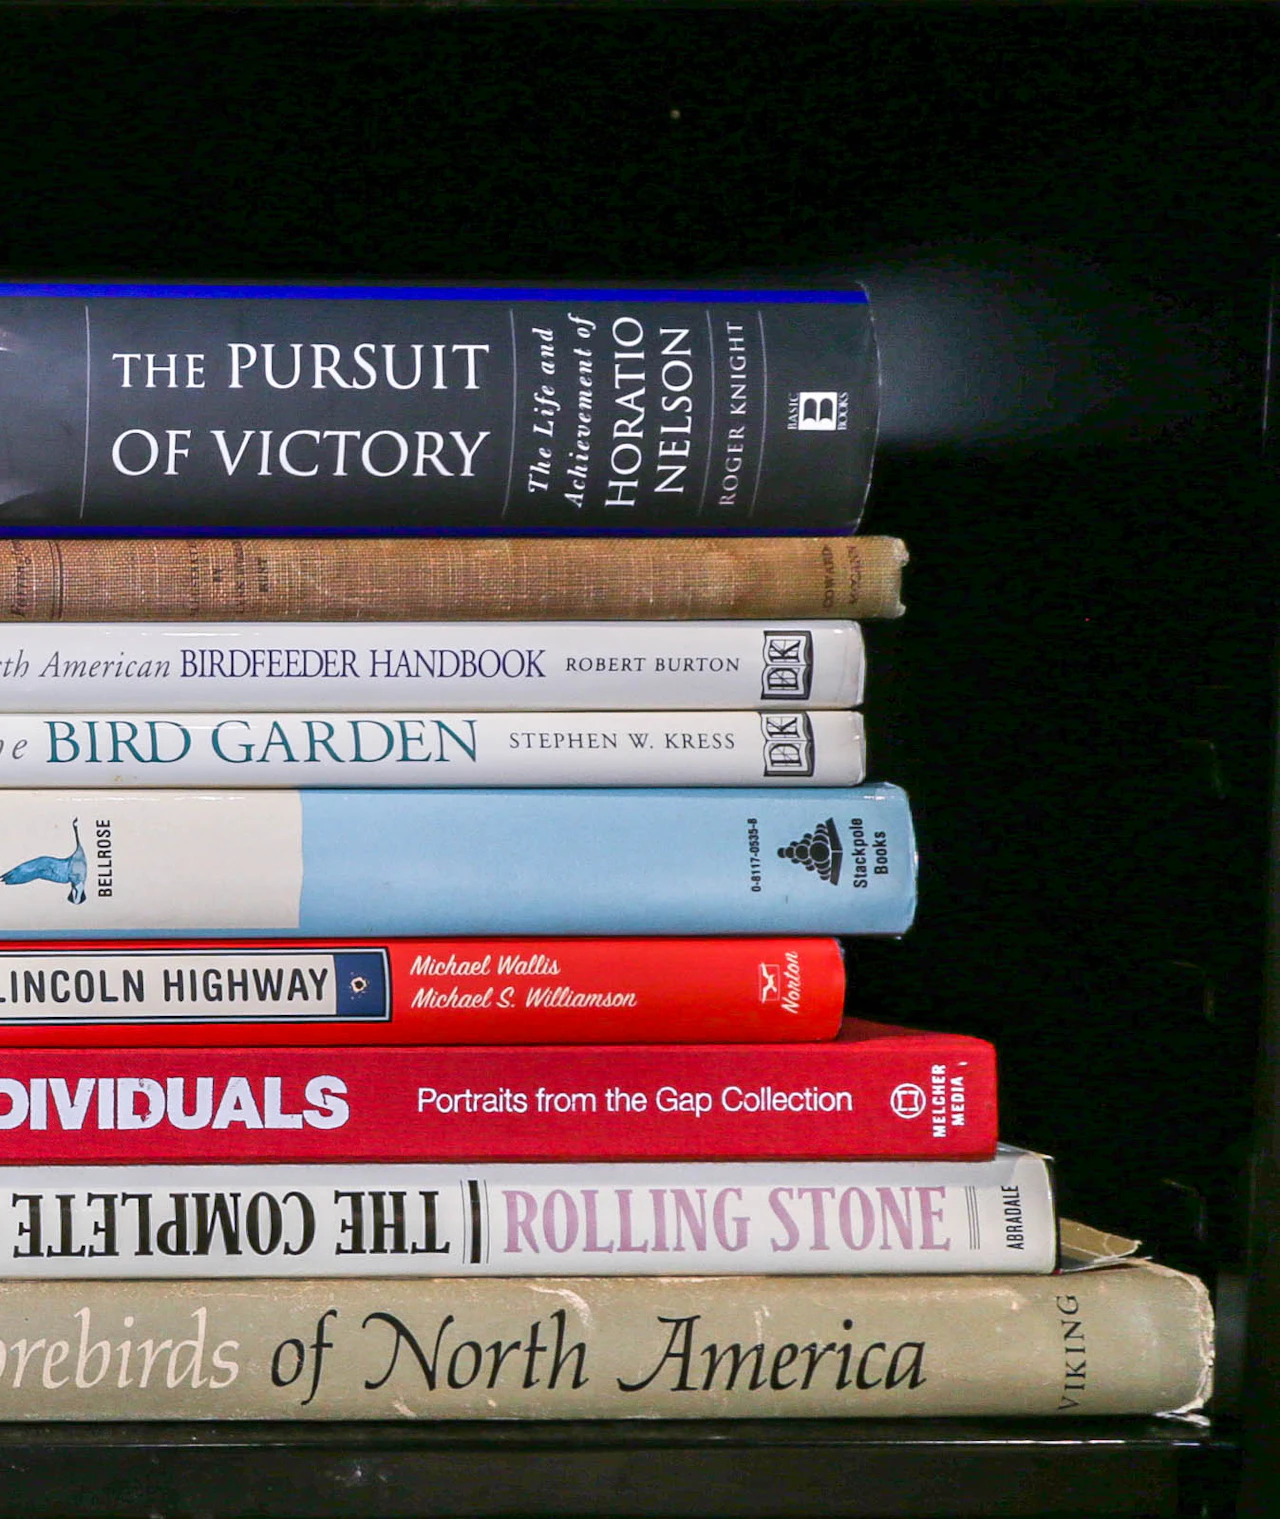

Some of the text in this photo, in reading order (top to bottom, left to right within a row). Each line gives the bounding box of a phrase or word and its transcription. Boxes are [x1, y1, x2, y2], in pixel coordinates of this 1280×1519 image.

[111, 342, 491, 390] THE PURSUIT
[528, 326, 562, 494] The Life and
[564, 313, 597, 509] Achievement of
[604, 316, 646, 508] HORATIO
[653, 326, 694, 494] NELSON
[718, 321, 748, 506] ROGER KNIGHT
[787, 393, 799, 431] BASIC
[837, 391, 850, 431] BOOKS
[111, 429, 492, 478] OF VICTORY
[38, 650, 171, 680] American
[180, 649, 360, 680] BIRDFEEDER
[369, 648, 547, 680] HANDBOOK
[565, 656, 647, 673] ROBERT
[655, 656, 741, 673] BURTON
[46, 720, 193, 764] BIRD
[211, 718, 479, 765] GARDEN
[509, 731, 618, 750] STEPHEN
[628, 732, 656, 750] W.
[665, 731, 736, 751] KRESS
[96, 818, 113, 898] BELLROSE
[747, 817, 762, 893] 0-8117-0535-8
[849, 817, 869, 889] Stackpole
[872, 831, 889, 875] Books
[162, 967, 330, 1002] HIGHWAY
[409, 954, 562, 977] Michael Wallis
[409, 986, 638, 1009] Michael S. Williamson
[781, 951, 801, 1015] Norton
[417, 1085, 853, 1118] Portraits from the Gap Collection
[931, 1064, 947, 1138] MELCHER
[950, 1076, 965, 1127] MEDIA
[13, 1191, 317, 1259] COMPLETE
[333, 1190, 452, 1255] THE
[501, 1185, 952, 1254] ROLLING STONE
[1000, 1185, 1025, 1250] ABRADALE
[270, 1309, 337, 1407] of
[362, 1309, 589, 1392] North
[617, 1314, 928, 1392] America
[1055, 1295, 1087, 1410] VIKING
